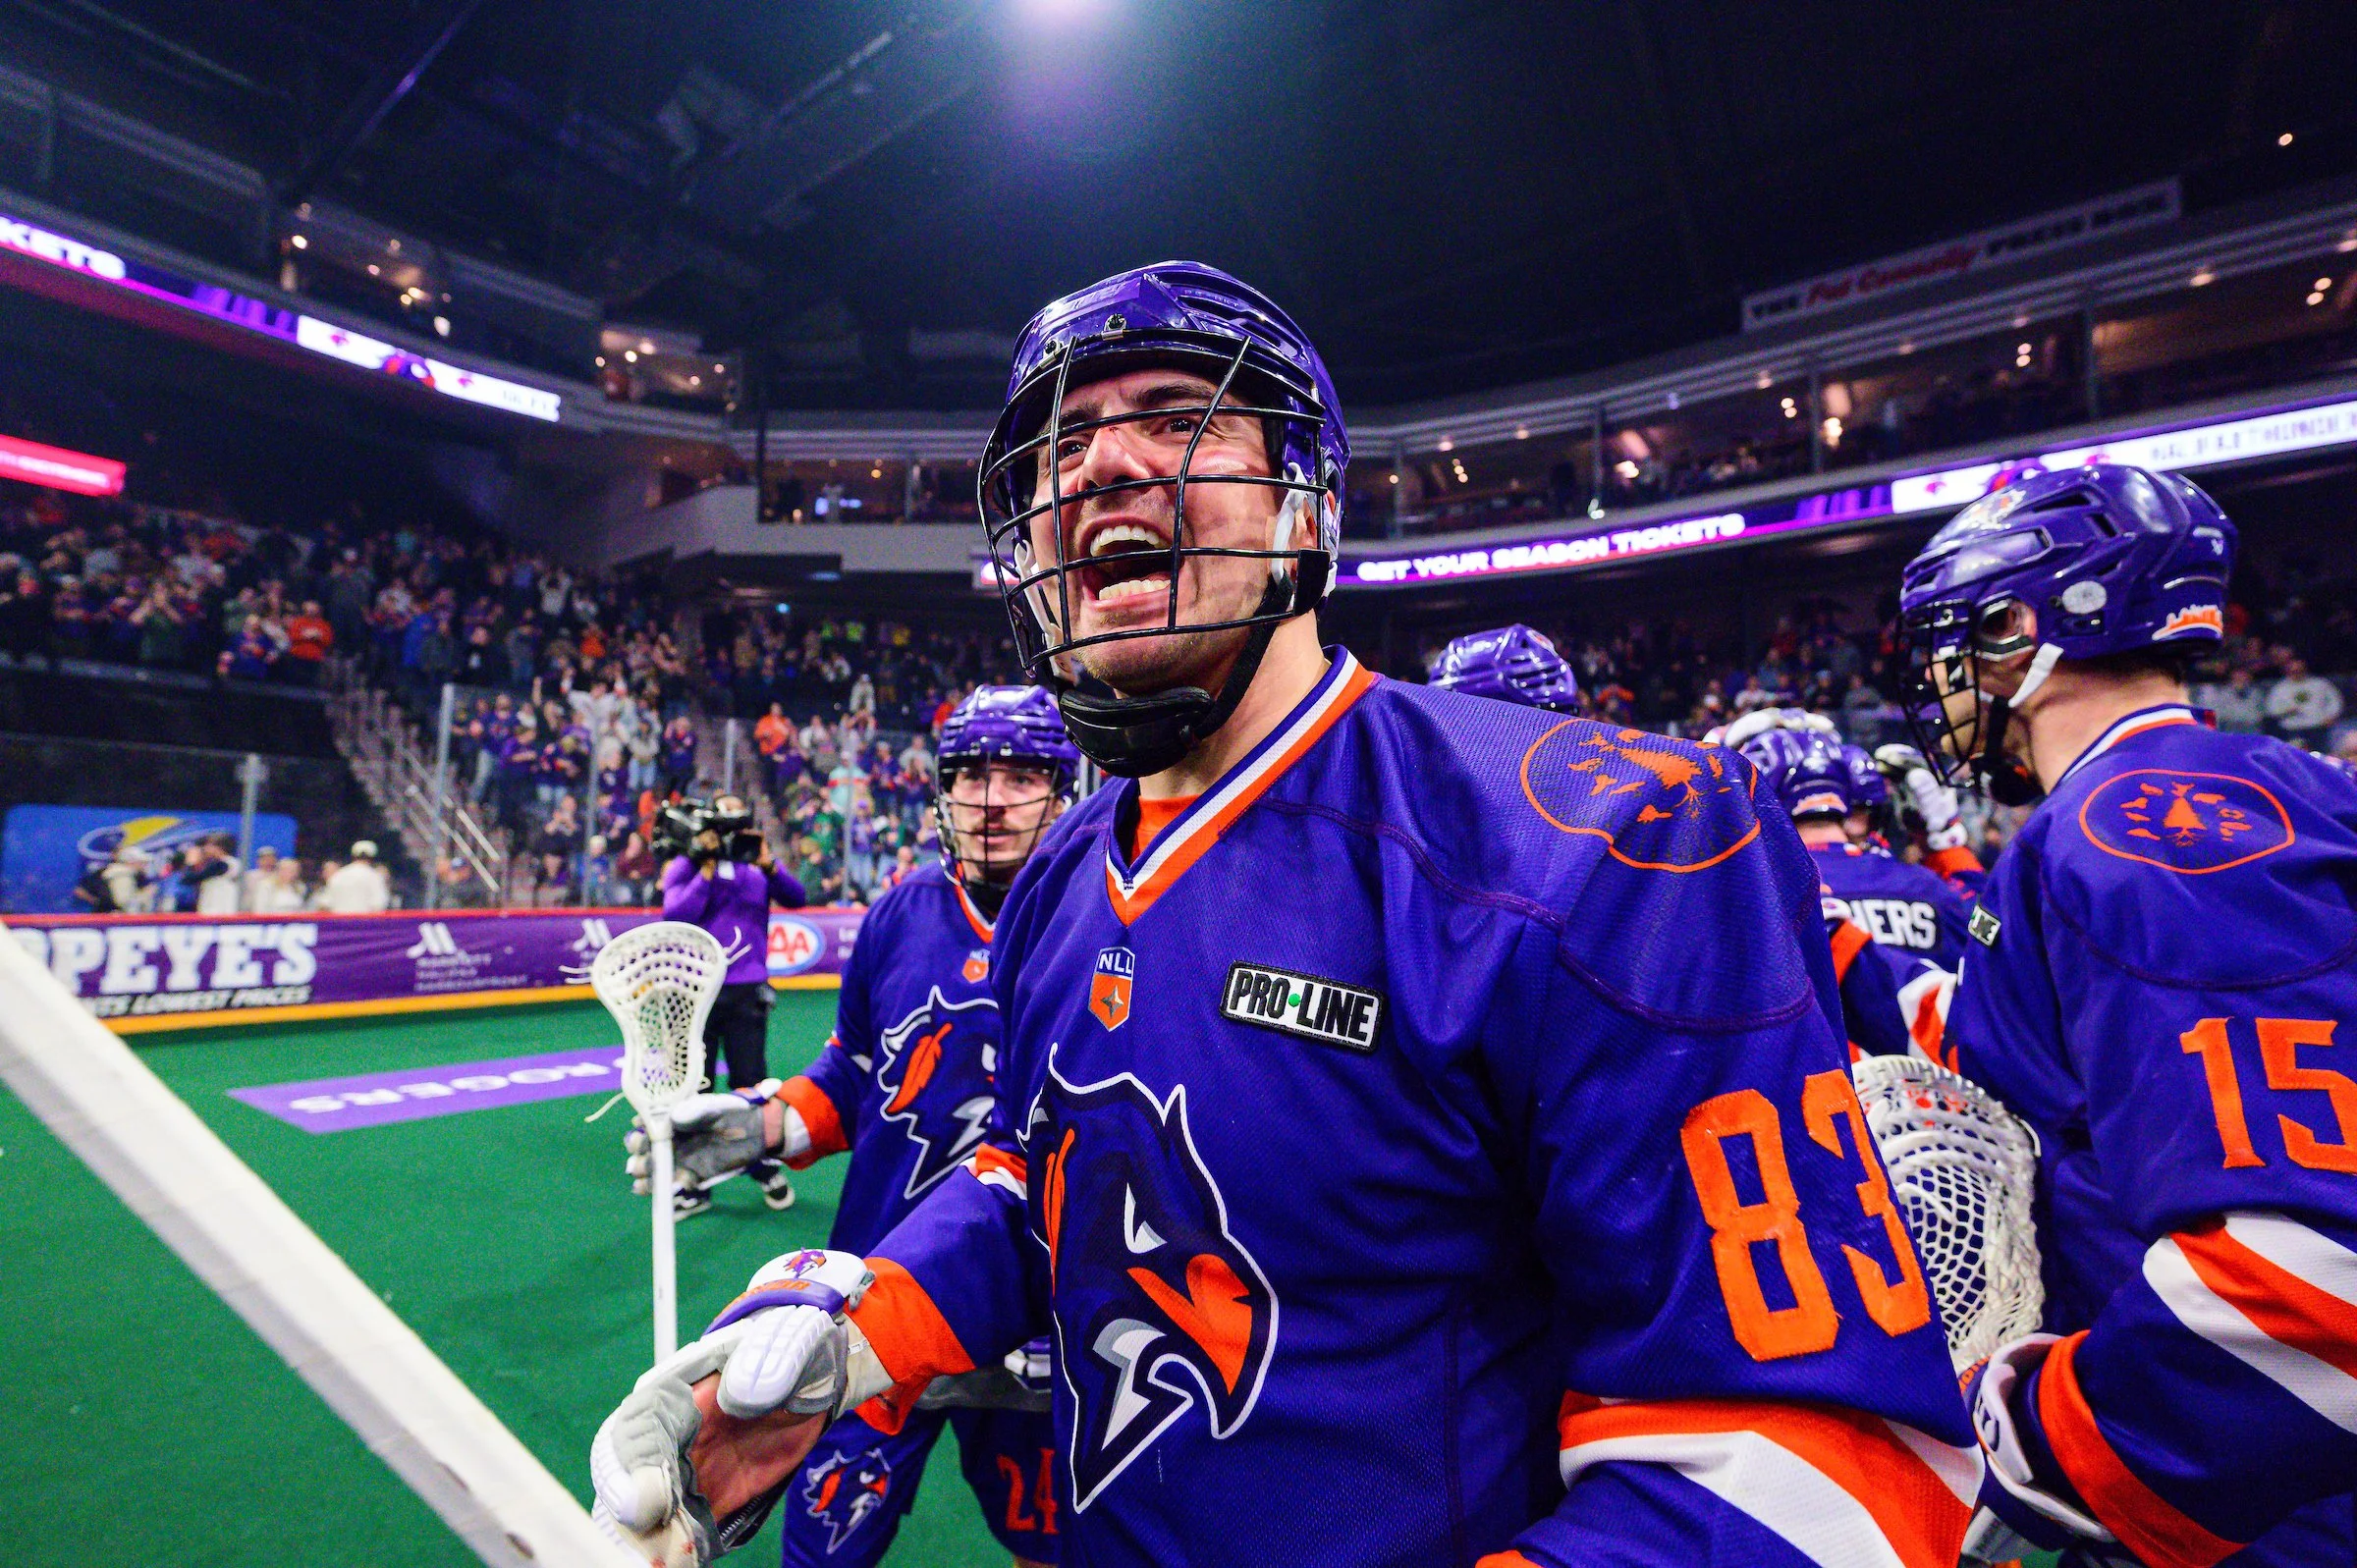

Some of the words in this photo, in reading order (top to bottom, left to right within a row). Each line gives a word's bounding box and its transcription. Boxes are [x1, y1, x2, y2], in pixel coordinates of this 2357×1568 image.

[1356, 560, 1411, 581] GET
[1412, 551, 1489, 577] YOUR
[1491, 535, 1610, 568] SEASON
[1611, 513, 1746, 554] TICKETS
[767, 925, 810, 965] AA
[1098, 951, 1132, 974] NLL
[289, 1062, 611, 1113] ROGERS
[2179, 1015, 2357, 1176] 15
[1680, 1068, 1931, 1362] 83
[996, 1446, 1060, 1535] 24
